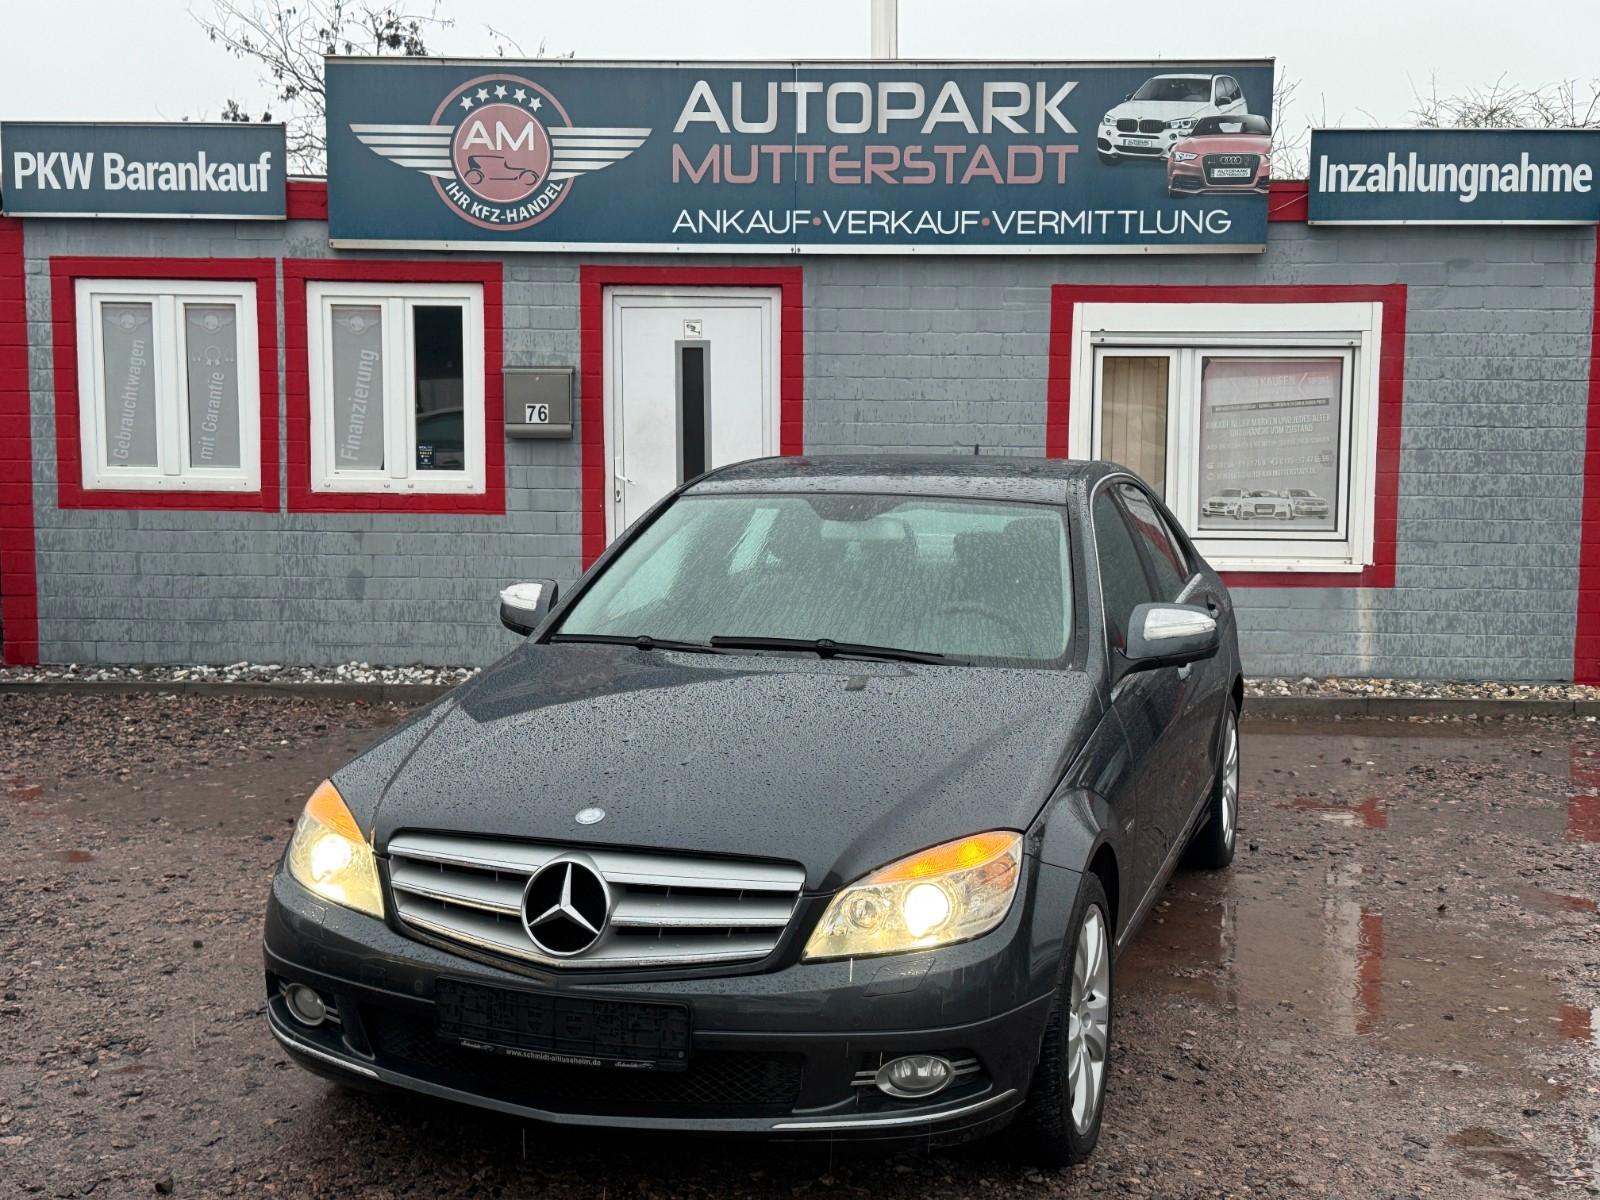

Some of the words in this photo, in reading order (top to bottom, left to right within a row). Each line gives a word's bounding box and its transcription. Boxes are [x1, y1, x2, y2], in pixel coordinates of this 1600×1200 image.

[672, 80, 1079, 134] AUTOPARK
[464, 120, 534, 152] AM
[13, 151, 94, 190] PKW
[103, 150, 272, 192] Barankauf
[672, 143, 1079, 184] MUTTERSTADT
[1318, 151, 1593, 203] Inzahlungnahme
[445, 182, 471, 209] IHR
[470, 182, 564, 223] KFZ-HANDEL
[672, 210, 811, 234] ANKAUF
[822, 210, 981, 235] VERKAUF
[991, 209, 1232, 235] VERMITTLUNG
[113, 339, 147, 460] Gebrauchtwagen
[201, 371, 226, 432] Garantie
[340, 348, 380, 462] Finanzierung
[527, 405, 547, 422] 76
[199, 435, 216, 462] mit
